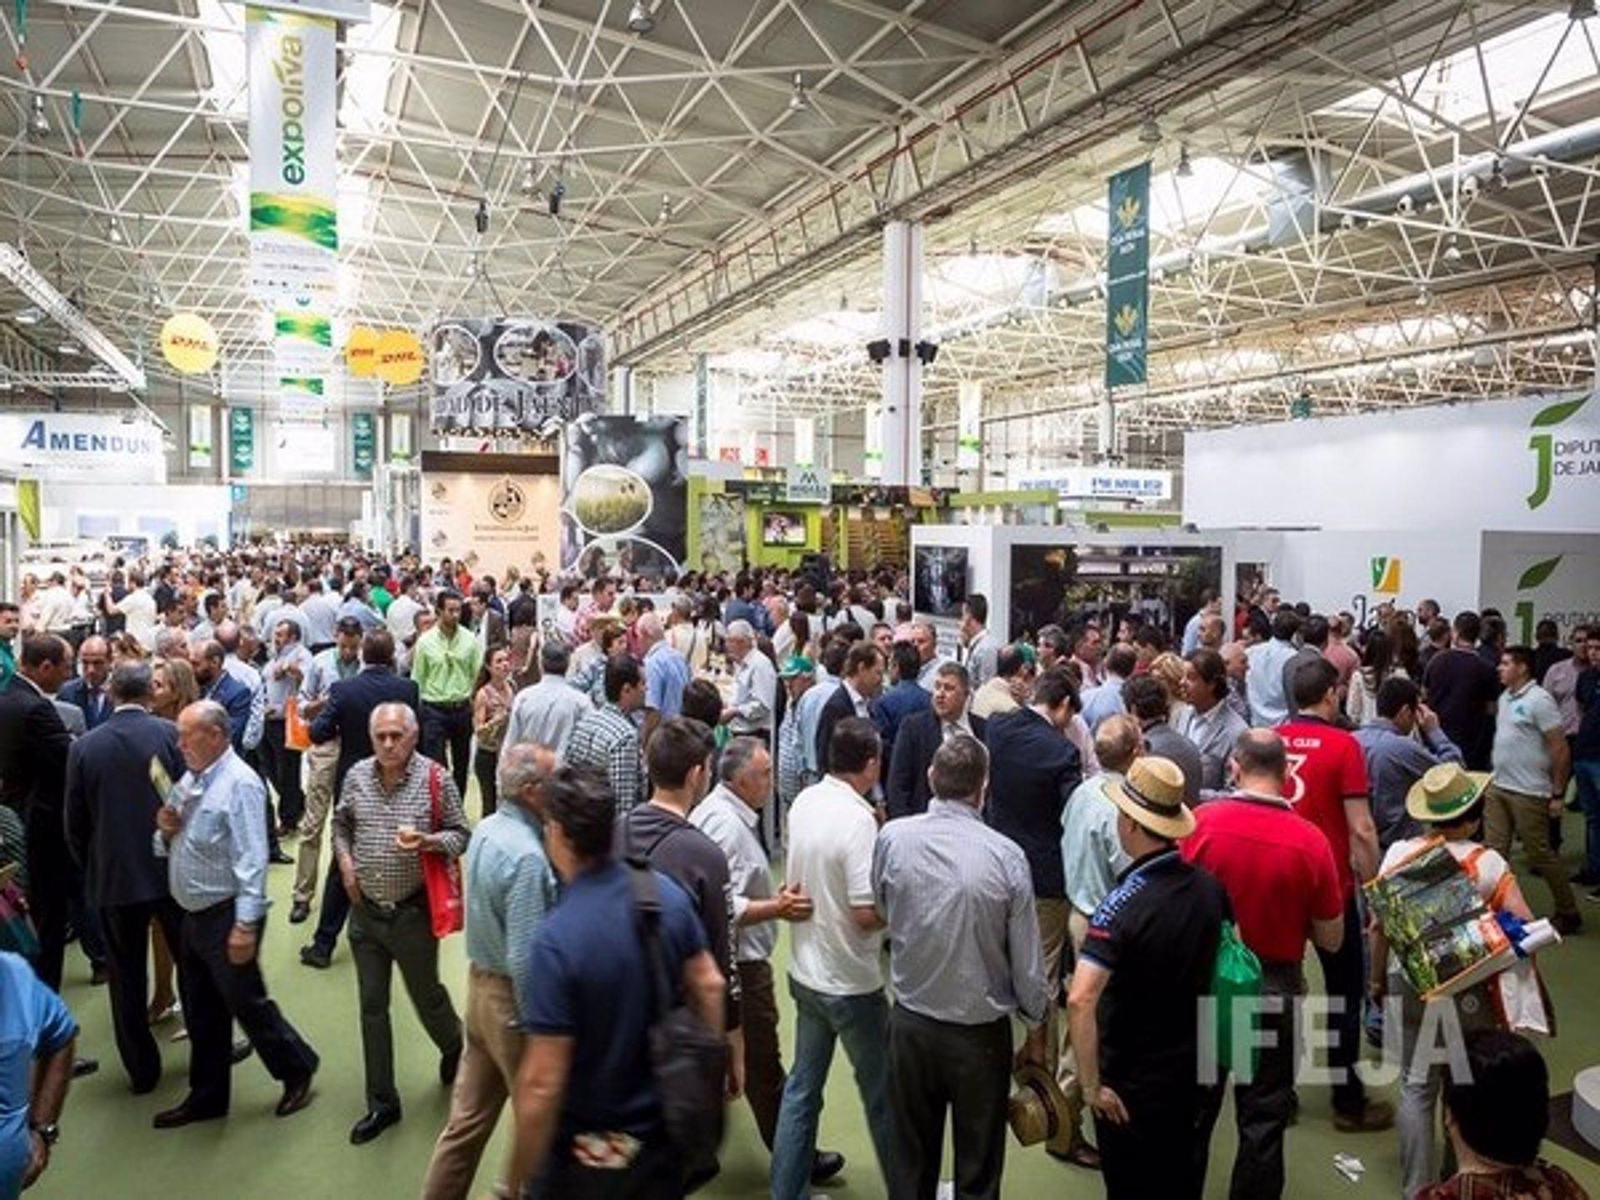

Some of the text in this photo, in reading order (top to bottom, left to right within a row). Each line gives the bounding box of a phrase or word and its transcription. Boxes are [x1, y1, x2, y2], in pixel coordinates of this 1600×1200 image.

[272, 35, 305, 185] expoliva
[21, 420, 155, 454] AMENDUN
[1554, 461, 1576, 475] DE
